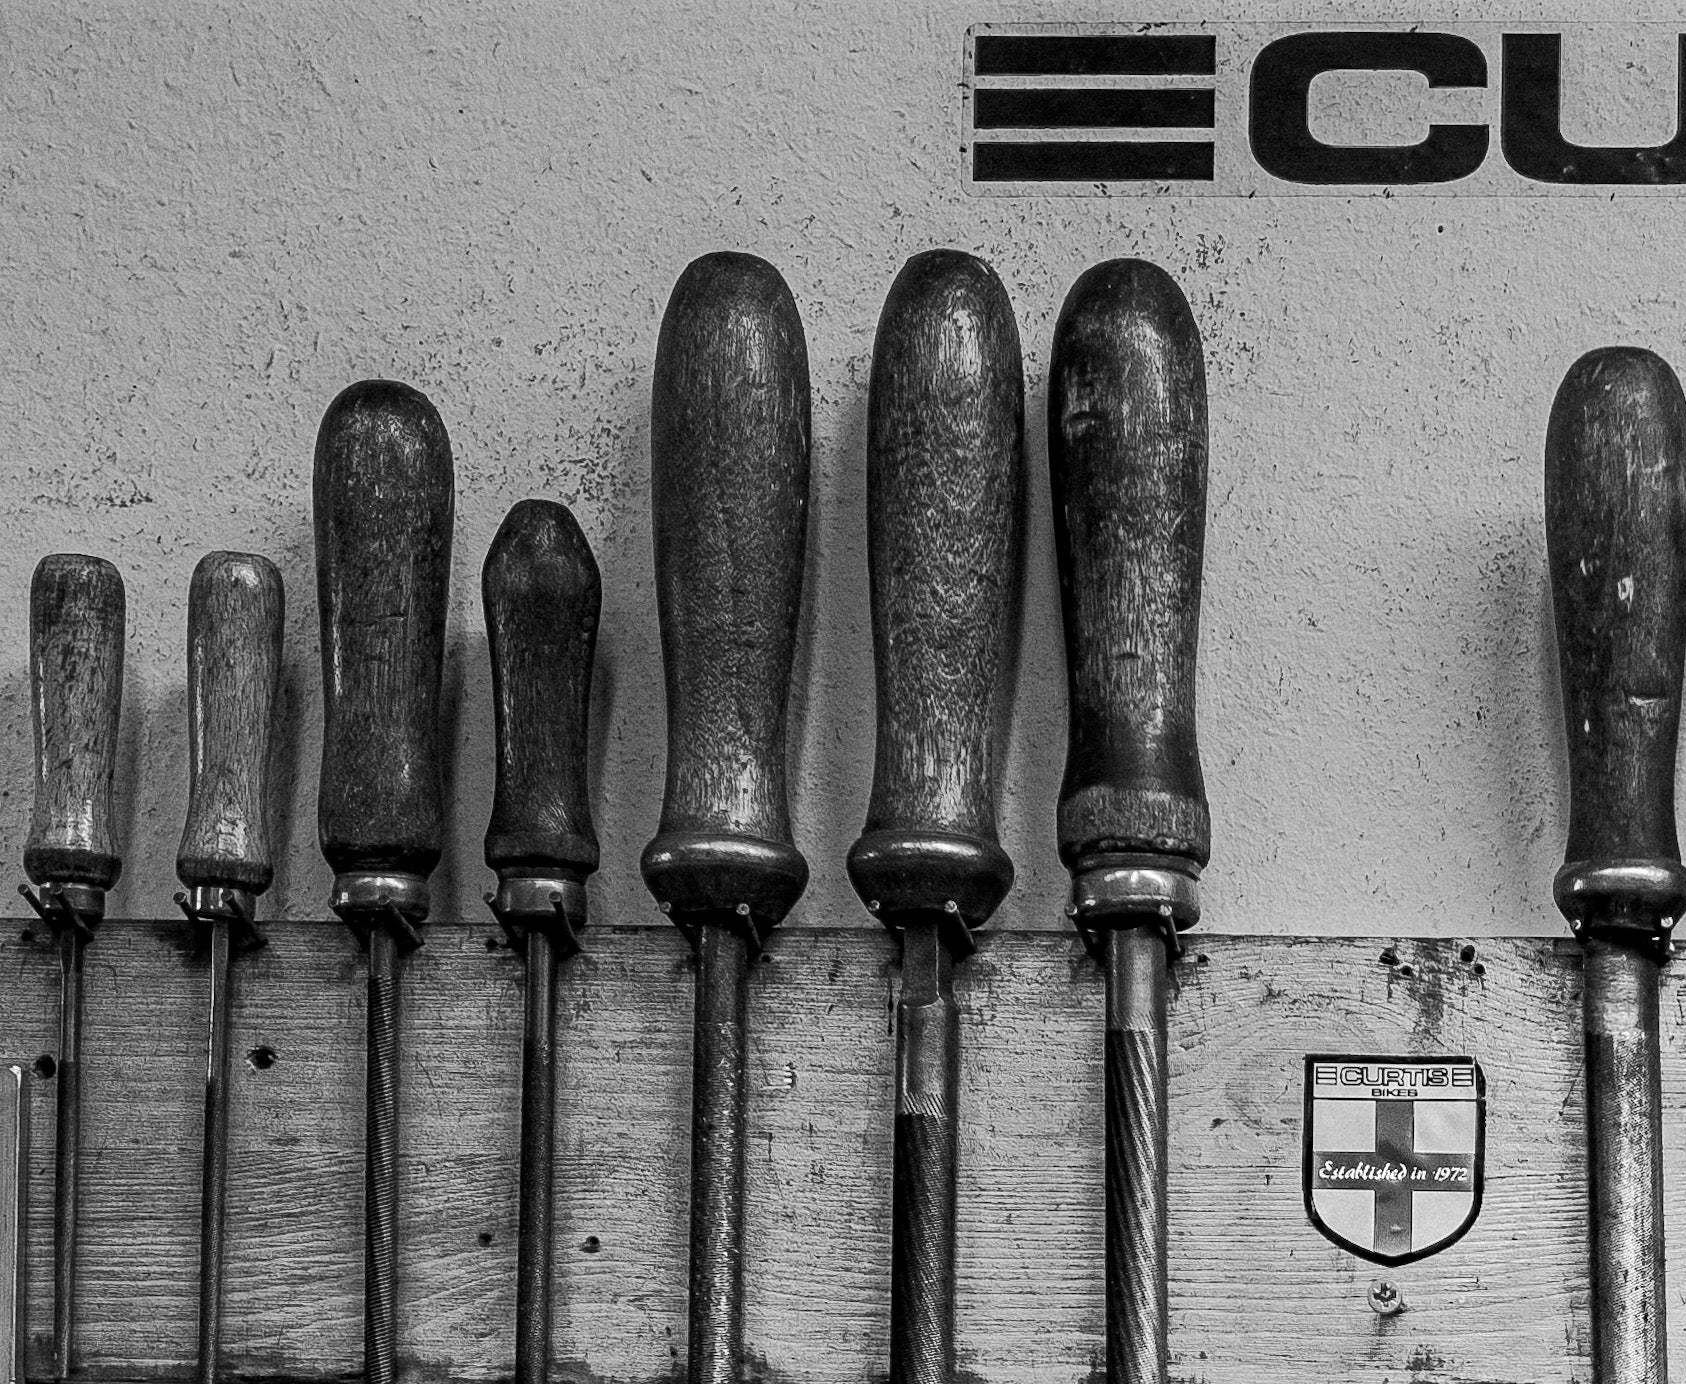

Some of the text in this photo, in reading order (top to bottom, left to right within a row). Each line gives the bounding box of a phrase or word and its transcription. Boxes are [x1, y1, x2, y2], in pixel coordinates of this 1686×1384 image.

[1339, 1066, 1450, 1087] CURTIS
[1371, 1088, 1418, 1097] BIKES
[1318, 1160, 1468, 1182] Established in 1972
